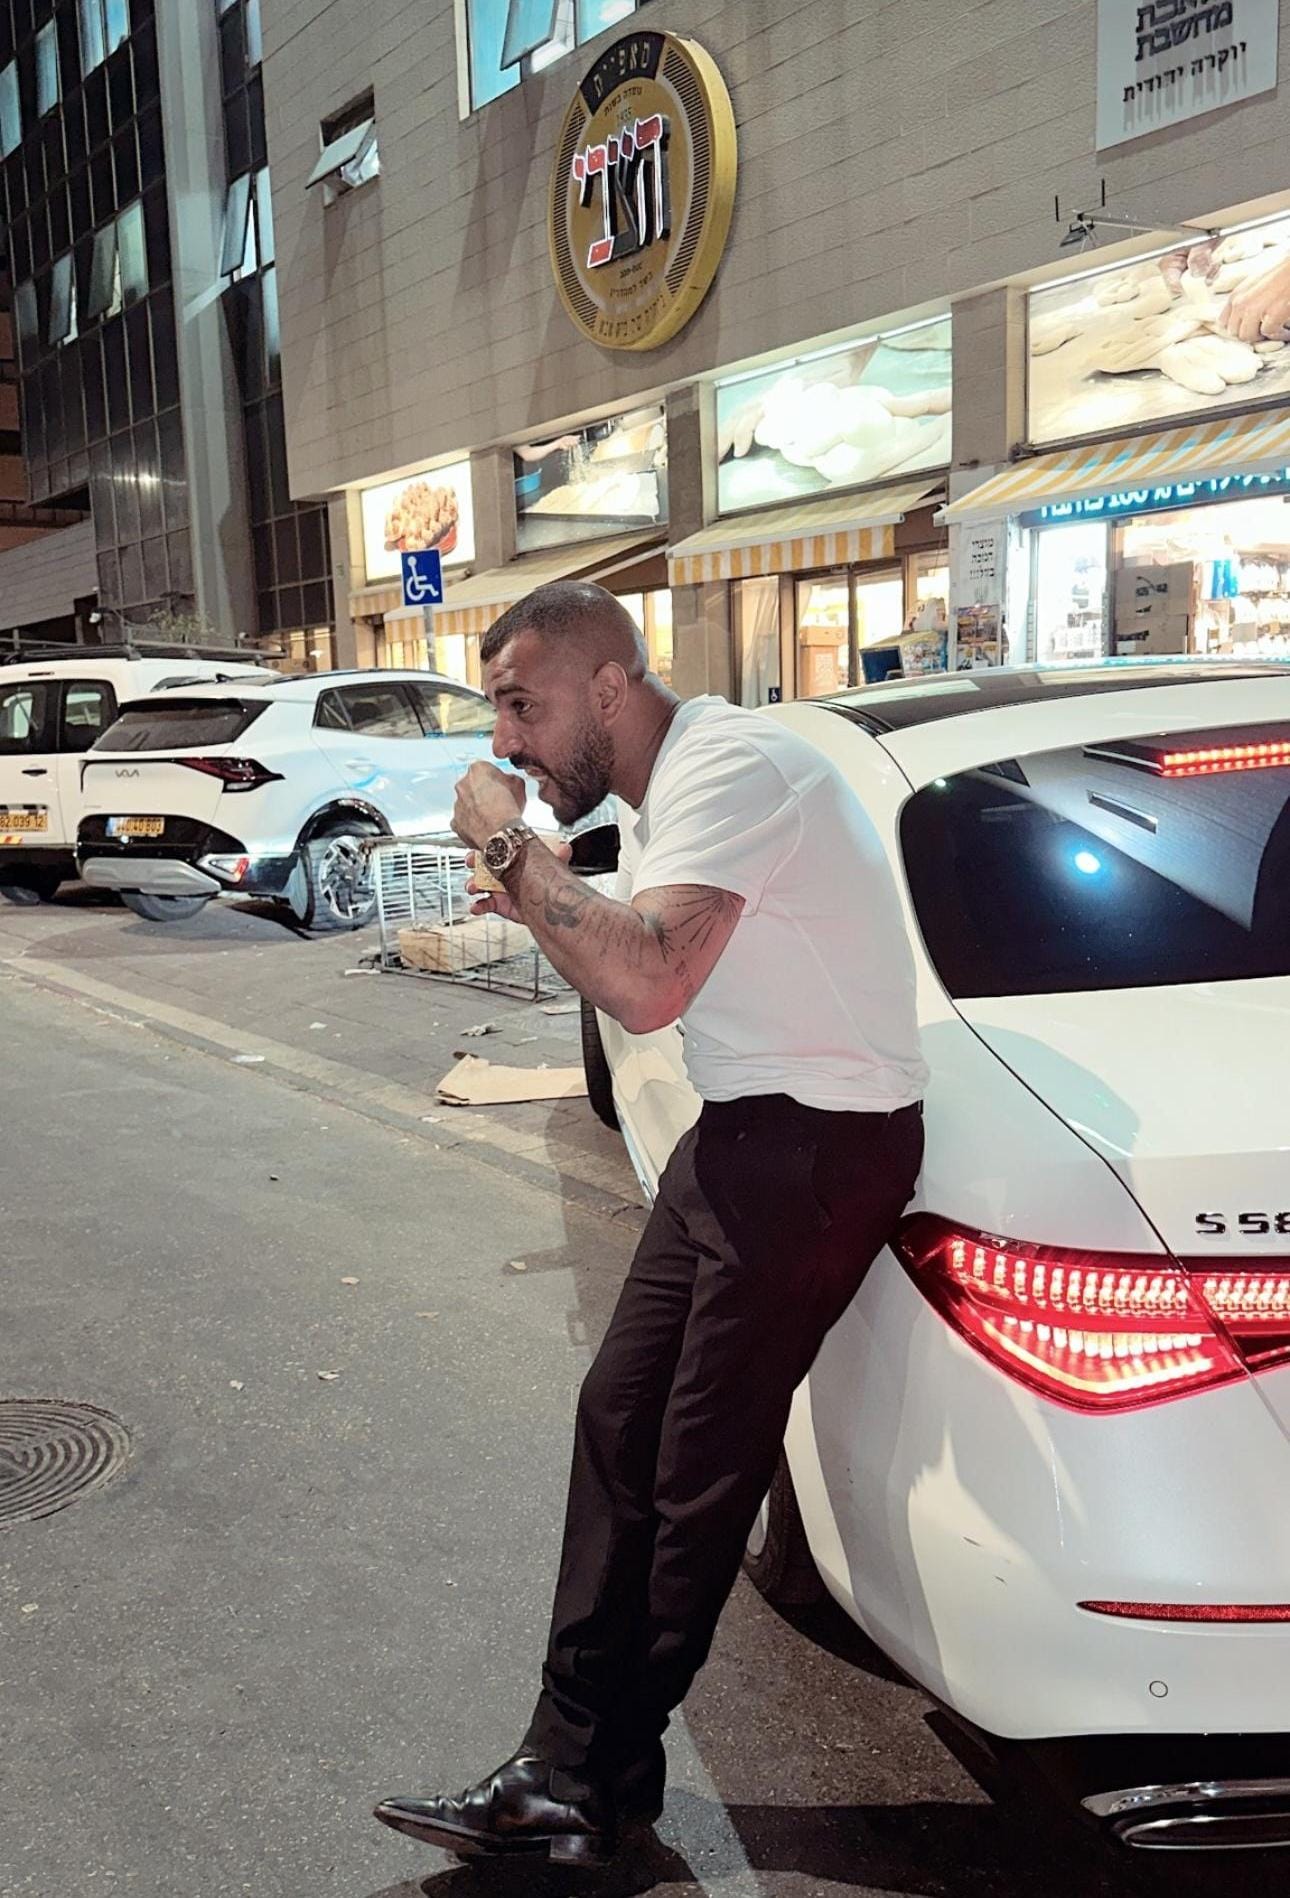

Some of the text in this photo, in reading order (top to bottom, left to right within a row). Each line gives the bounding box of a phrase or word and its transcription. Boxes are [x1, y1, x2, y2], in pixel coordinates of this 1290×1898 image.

[1135, 1, 1232, 61] מחשבת
[593, 41, 650, 98] מאפיית
[1190, 42, 1247, 76] יוקרה
[1195, 1212, 1226, 1234] S
